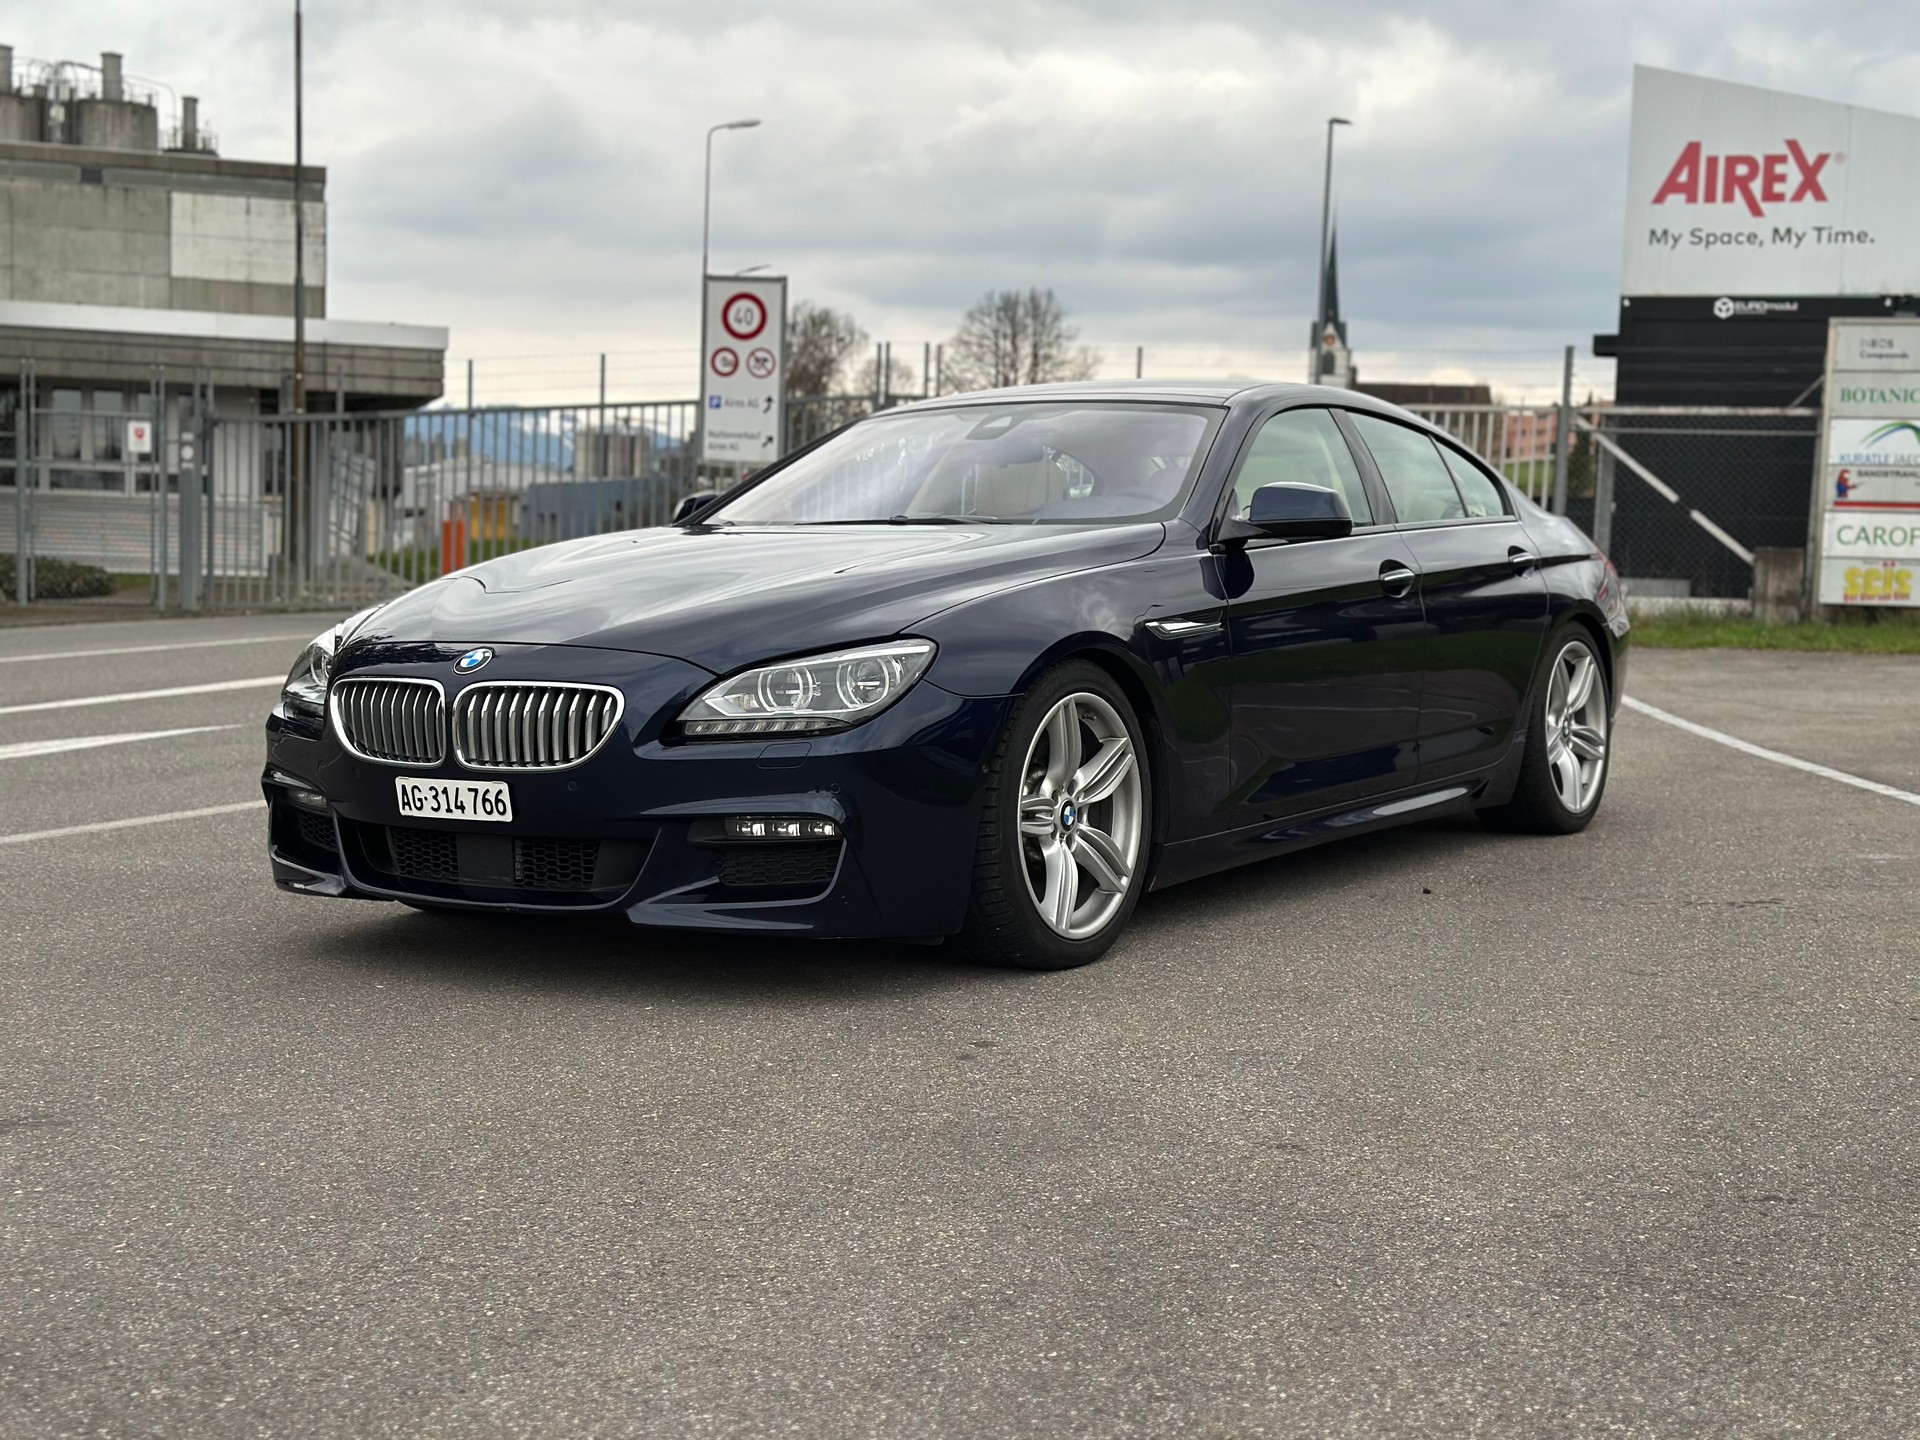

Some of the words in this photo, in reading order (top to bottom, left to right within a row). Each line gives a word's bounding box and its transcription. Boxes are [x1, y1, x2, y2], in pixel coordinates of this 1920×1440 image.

[1652, 139, 1832, 217] AIREX
[1649, 229, 1682, 249] My
[1690, 228, 1764, 248] Space,
[1772, 227, 1806, 247] My
[1813, 226, 1875, 244] Time.
[734, 308, 754, 326] 40
[1837, 526, 1920, 547] CAROF
